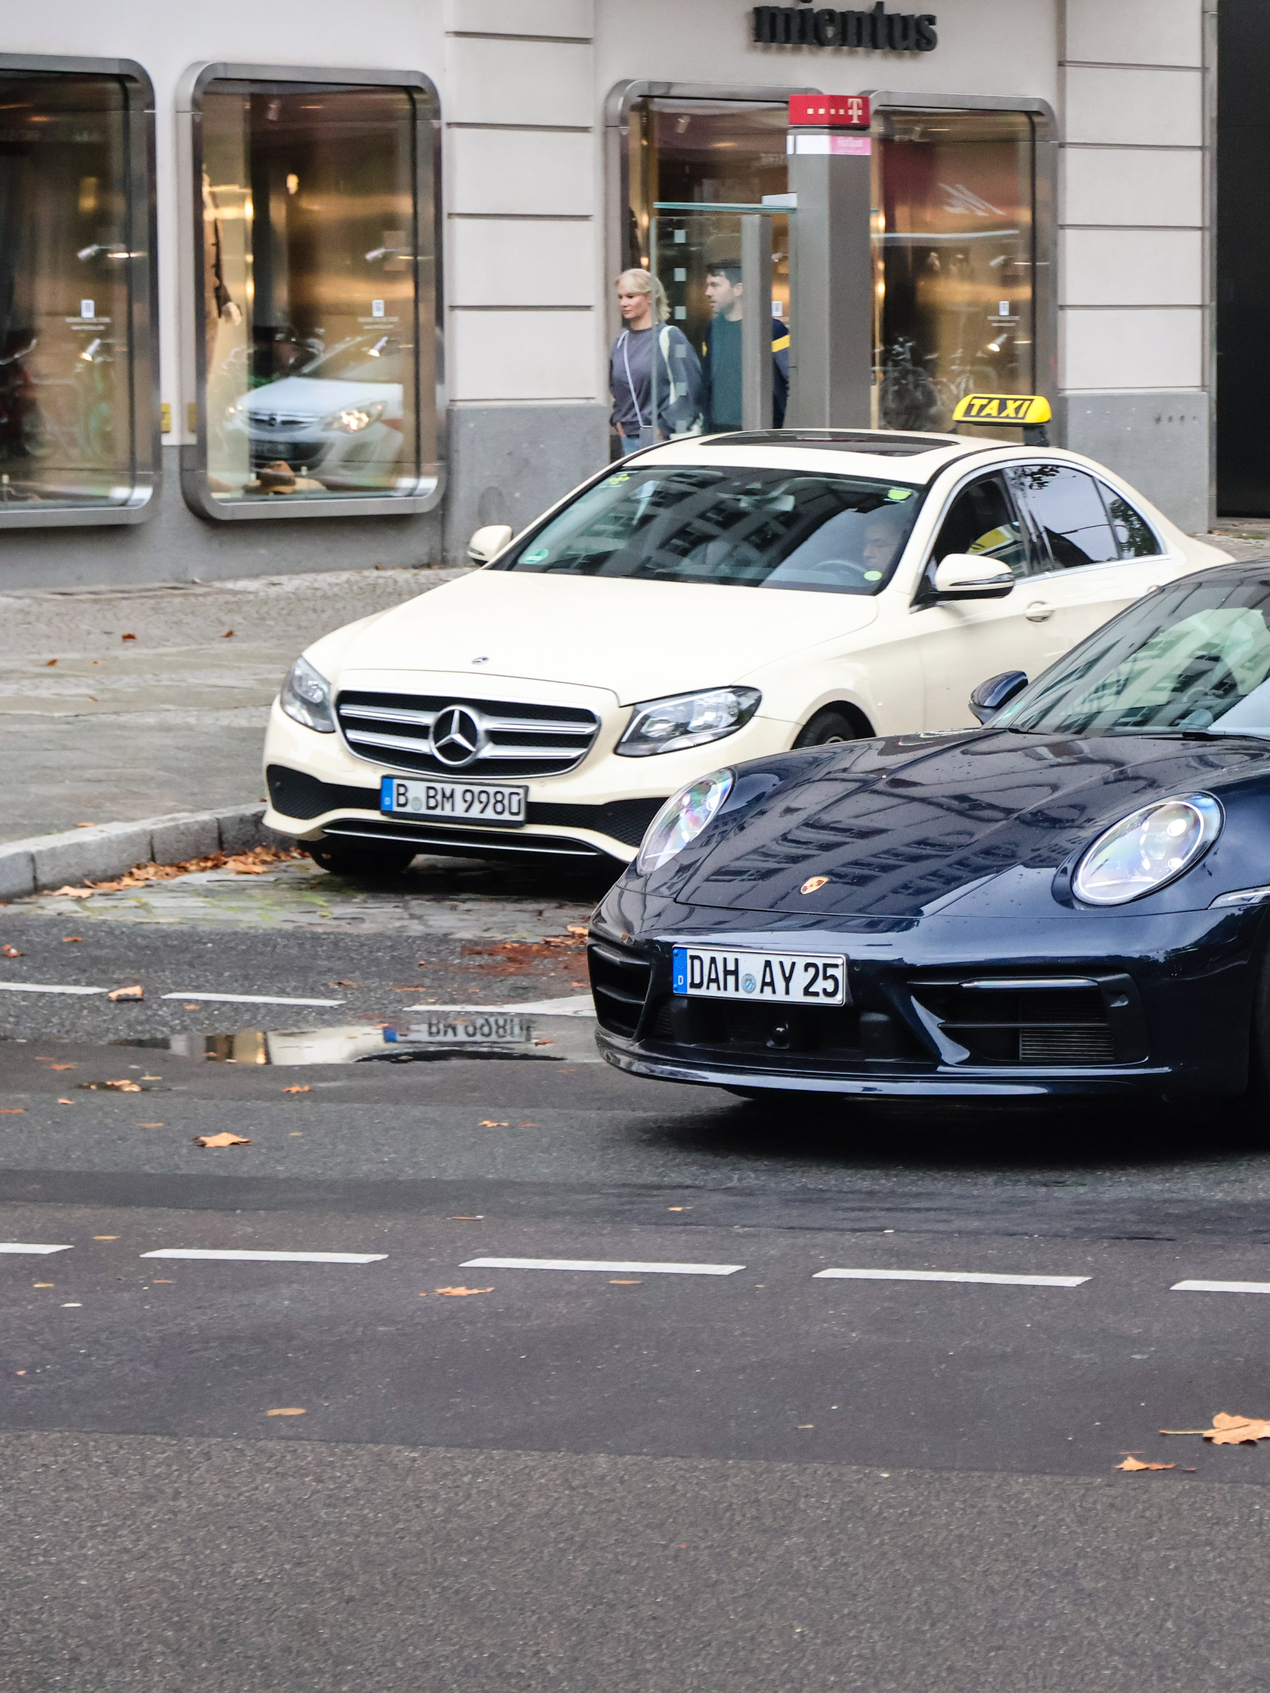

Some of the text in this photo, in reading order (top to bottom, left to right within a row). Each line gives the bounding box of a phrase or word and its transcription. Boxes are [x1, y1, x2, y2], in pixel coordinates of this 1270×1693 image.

[753, 0, 938, 52] mientus
[970, 398, 1032, 418] TAXI
[396, 783, 522, 816] B BM 9980
[677, 974, 684, 986] D
[689, 954, 840, 998] DAH AY 25
